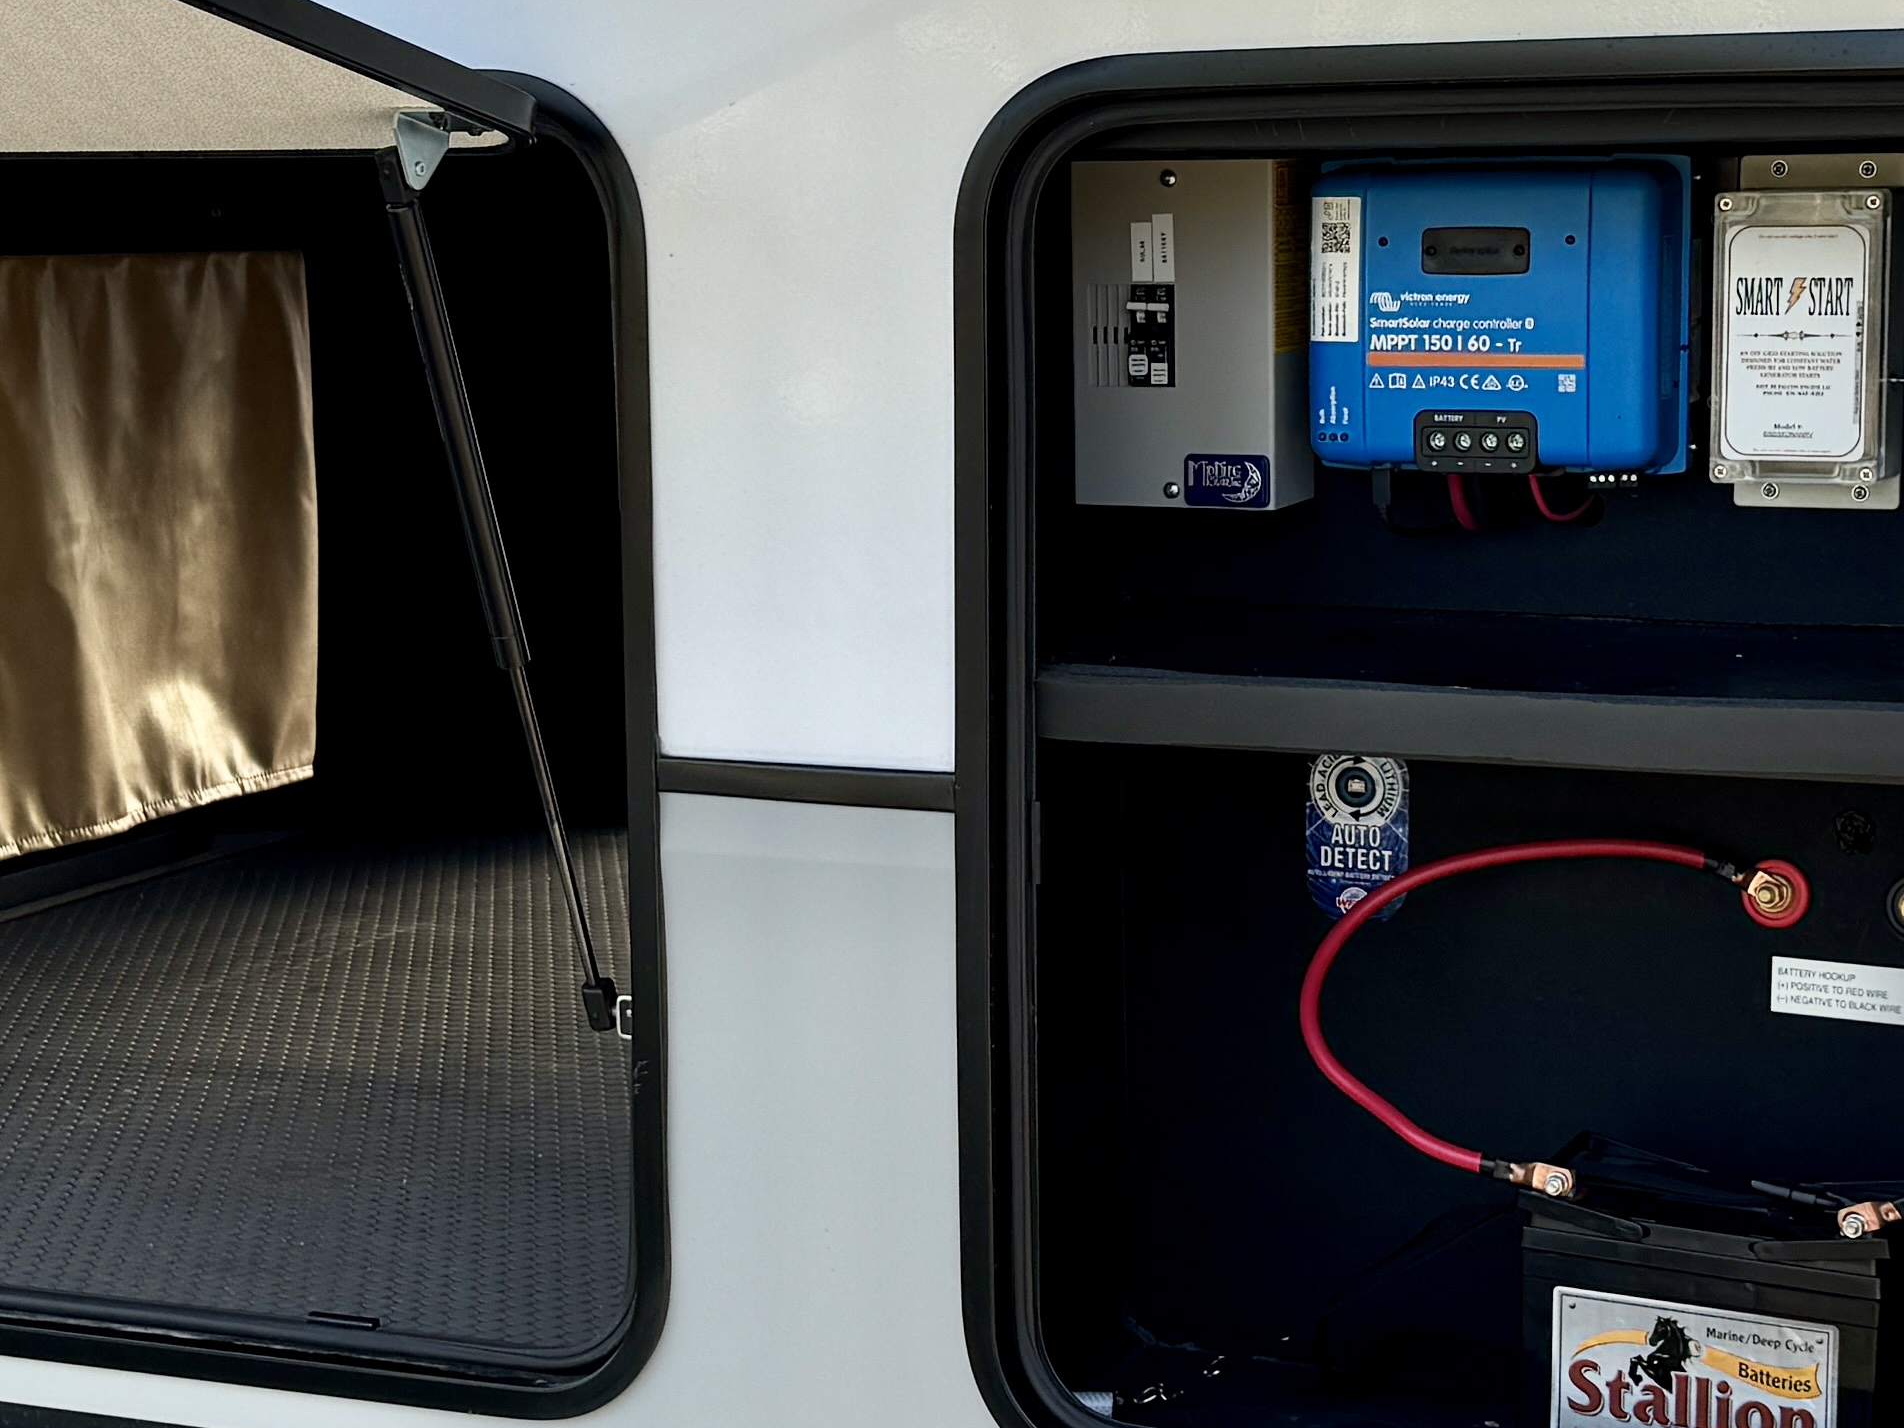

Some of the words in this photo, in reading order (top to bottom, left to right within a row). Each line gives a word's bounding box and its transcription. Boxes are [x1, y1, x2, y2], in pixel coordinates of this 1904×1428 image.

[1400, 291, 1434, 302] victron
[1436, 294, 1470, 304] energy
[1736, 277, 1783, 316] SMART
[1808, 277, 1853, 316] START
[1370, 317, 1429, 329] SmartSolar
[1433, 319, 1470, 332] charge
[1473, 318, 1522, 330] controller
[1370, 335, 1418, 351] MPPT
[1423, 335, 1452, 351] 150
[1467, 336, 1490, 352] 60
[1508, 338, 1522, 353] Tr
[1429, 376, 1455, 388] IP43
[1434, 414, 1464, 422] BATTERY
[1376, 762, 1395, 817] LITHIUM
[1316, 783, 1339, 818] LEAD
[1331, 824, 1381, 847] AUTO
[1320, 846, 1392, 871] DETECT
[1778, 967, 1817, 978] BATTERY
[1818, 972, 1856, 982] HOOKUP
[1778, 981, 1789, 990] (+)
[1790, 982, 1829, 994] POSITIVE
[1832, 986, 1843, 995] TO
[1846, 987, 1864, 997] RED
[1866, 990, 1888, 999] WIRE
[1790, 995, 1832, 1008] NEGATIVE
[1836, 999, 1846, 1009] TO
[1849, 1001, 1877, 1012] BLACK
[1879, 1005, 1902, 1014] WIRE
[1706, 1327, 1782, 1350] Marine/Deep
[1785, 1339, 1815, 1354] Cycle
[1737, 1362, 1812, 1393] Batteries
